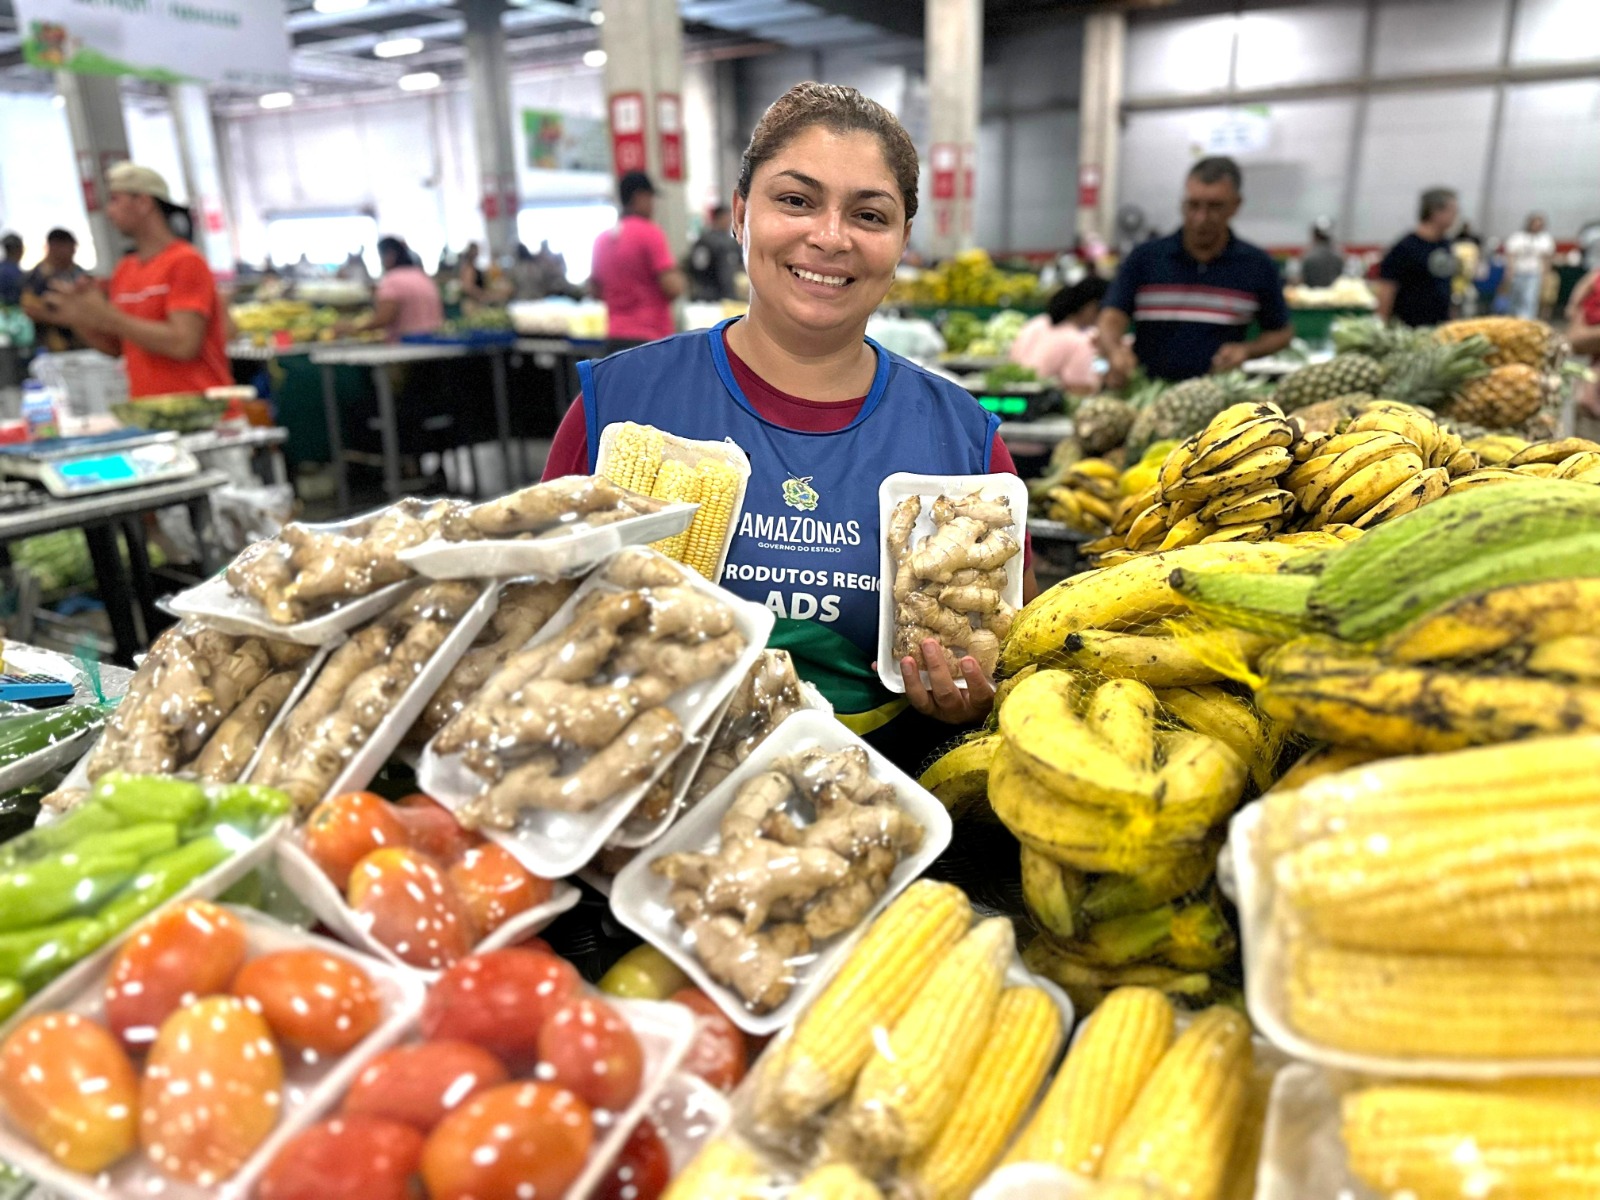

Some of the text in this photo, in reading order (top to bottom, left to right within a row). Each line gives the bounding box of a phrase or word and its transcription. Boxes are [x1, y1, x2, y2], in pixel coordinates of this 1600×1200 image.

[739, 512, 861, 546] AMAZONAS
[758, 541, 796, 551] GOVERNO
[723, 563, 828, 586] RODUTOS
[764, 590, 841, 622] ADS
